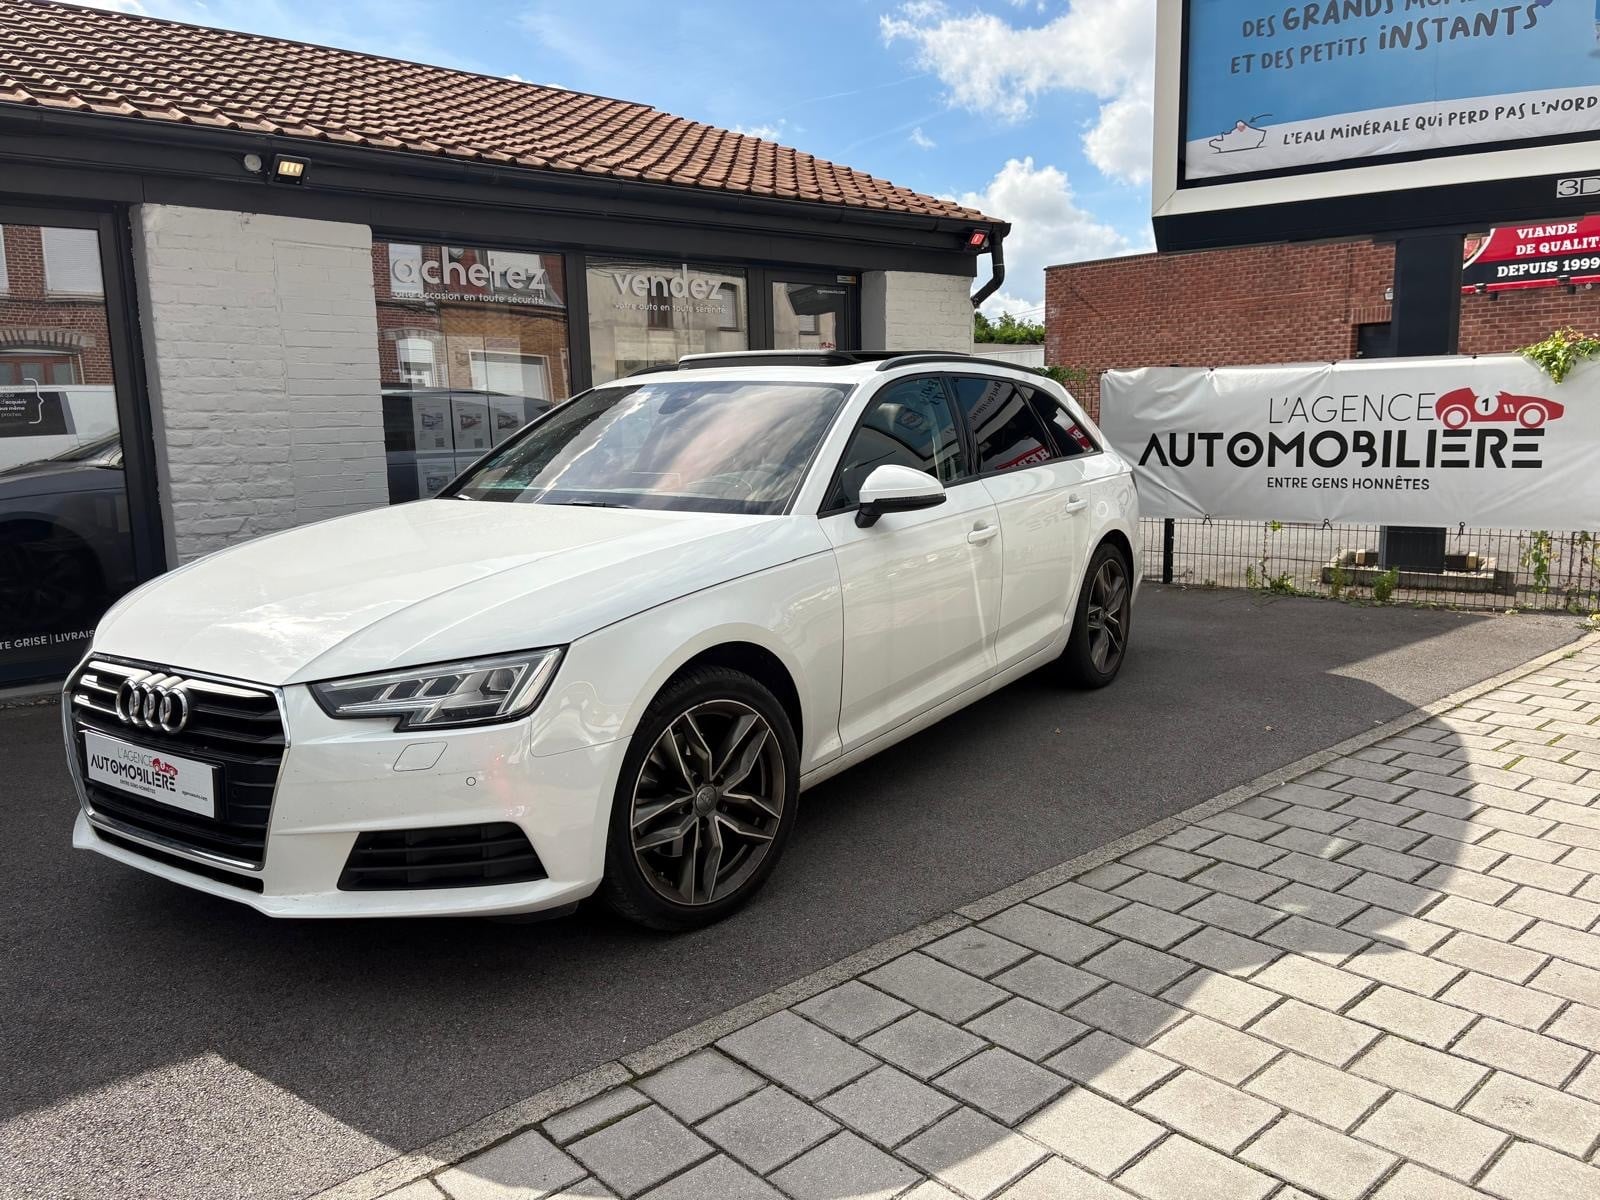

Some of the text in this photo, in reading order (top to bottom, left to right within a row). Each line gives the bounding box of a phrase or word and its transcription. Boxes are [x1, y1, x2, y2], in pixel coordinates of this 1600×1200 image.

[1242, 15, 1276, 38] DES
[1282, 0, 1394, 31] GRANDS
[1230, 54, 1255, 74] ET
[1261, 48, 1294, 69] DES
[1283, 129, 1325, 145] L'EAU
[1448, 109, 1489, 126] PERD
[1495, 102, 1526, 120] PAS
[1531, 96, 1598, 115] L'NORD
[1516, 223, 1578, 239] VIANDE
[1516, 236, 1600, 256] DE QUALIT
[392, 246, 546, 290] achetez
[1497, 257, 1600, 277] DEPUIS 1999
[613, 264, 723, 300] vendez
[418, 290, 461, 301] occasion
[463, 293, 476, 301] en
[479, 293, 504, 303] toute
[639, 302, 658, 311] auto
[673, 304, 693, 313] toute
[1268, 392, 1435, 424] L'AGENCE
[1481, 397, 1490, 412] 1
[1267, 475, 1430, 490] ENTRE GENS HONNÊTES
[14, 635, 47, 648] GRISE
[117, 747, 153, 767] L'AGENCE
